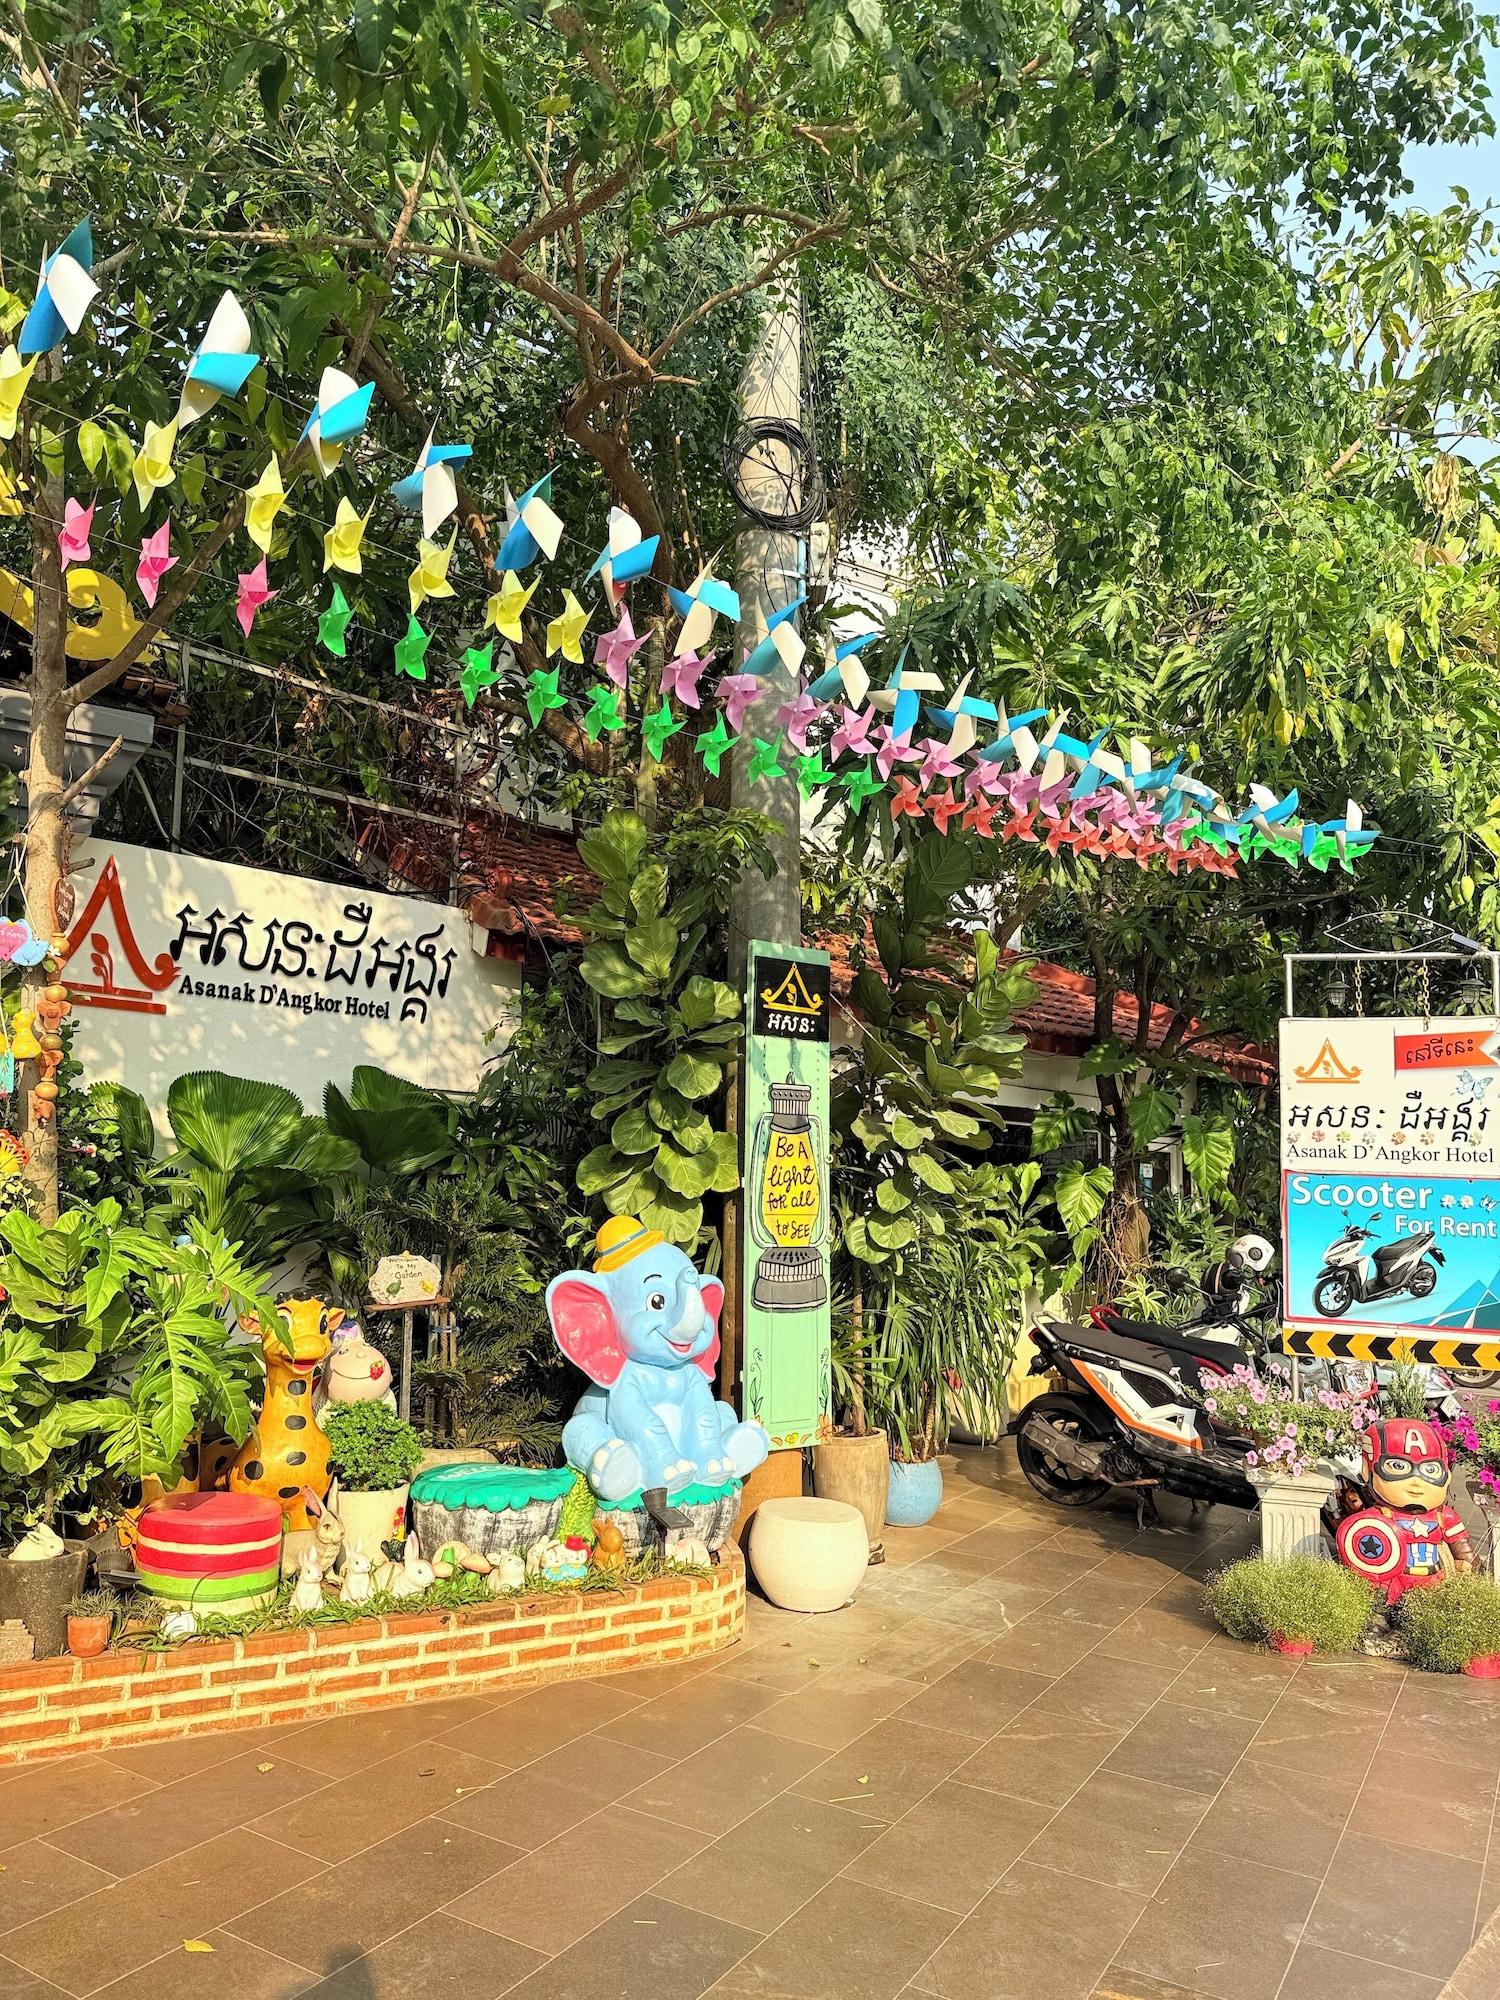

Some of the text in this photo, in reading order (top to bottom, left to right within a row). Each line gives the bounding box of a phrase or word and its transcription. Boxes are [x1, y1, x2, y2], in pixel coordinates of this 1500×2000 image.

[178, 974, 255, 1003] Asanak
[344, 996, 390, 1020] Hotel
[776, 1135, 809, 1160] Be A
[1286, 1144, 1347, 1159] Asanak
[1445, 1147, 1494, 1163] Hotel
[767, 1164, 815, 1194] light
[791, 1190, 815, 1209] all
[1291, 1176, 1433, 1210] Scooter
[776, 1218, 789, 1236] to
[1395, 1214, 1497, 1239] For Rent
[394, 1271, 423, 1280] Garden
[407, 1263, 417, 1271] My
[1404, 1428, 1428, 1456] A
